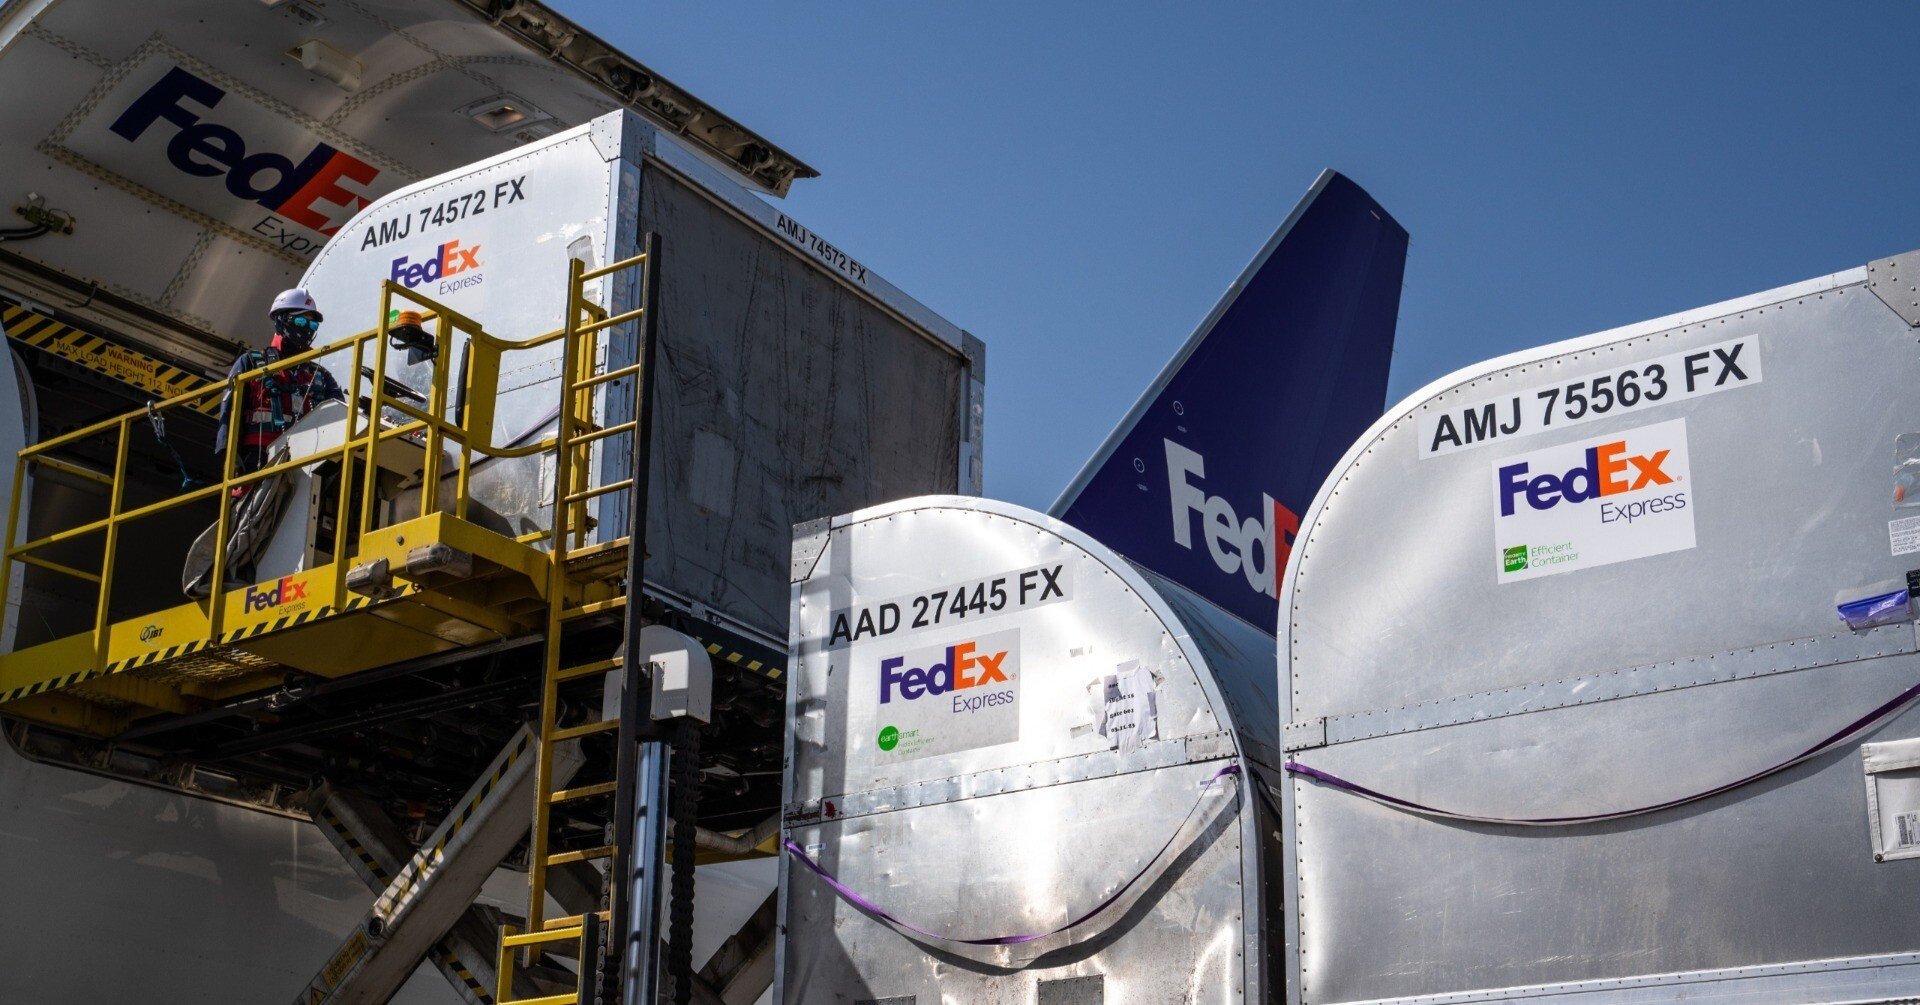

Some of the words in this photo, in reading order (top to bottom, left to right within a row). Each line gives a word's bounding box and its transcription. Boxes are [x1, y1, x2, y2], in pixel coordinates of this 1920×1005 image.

[109, 66, 380, 237] FedE
[361, 214, 411, 251] AMJ
[420, 189, 486, 232] 74572
[494, 175, 526, 208] FX
[252, 216, 325, 254] Expr
[777, 214, 805, 243] AMJ
[810, 234, 846, 271] 74572
[851, 261, 866, 284] FX
[391, 240, 481, 288] FedEx
[439, 274, 483, 295] Express
[56, 341, 78, 355] MAX
[81, 349, 107, 367] LOAD
[110, 362, 145, 382] HEIGHT
[149, 378, 162, 389] 112
[108, 349, 154, 373] WARNING
[1431, 397, 1522, 452] AMJ
[1537, 363, 1668, 426] 75563
[1684, 342, 1748, 392] FX
[1499, 440, 1674, 517] FedEx
[1164, 437, 1300, 600] FedE
[1601, 493, 1686, 524] Express
[1505, 557, 1526, 566] Earth
[1531, 541, 1573, 557] Efficient
[1532, 552, 1579, 568] Container
[244, 576, 308, 614] FedEx
[279, 601, 306, 615] Express
[829, 603, 900, 646] AAD
[912, 578, 1006, 628] 27445
[1020, 565, 1064, 605] FX
[880, 641, 1008, 704] FedEx
[953, 690, 1014, 713] Express
